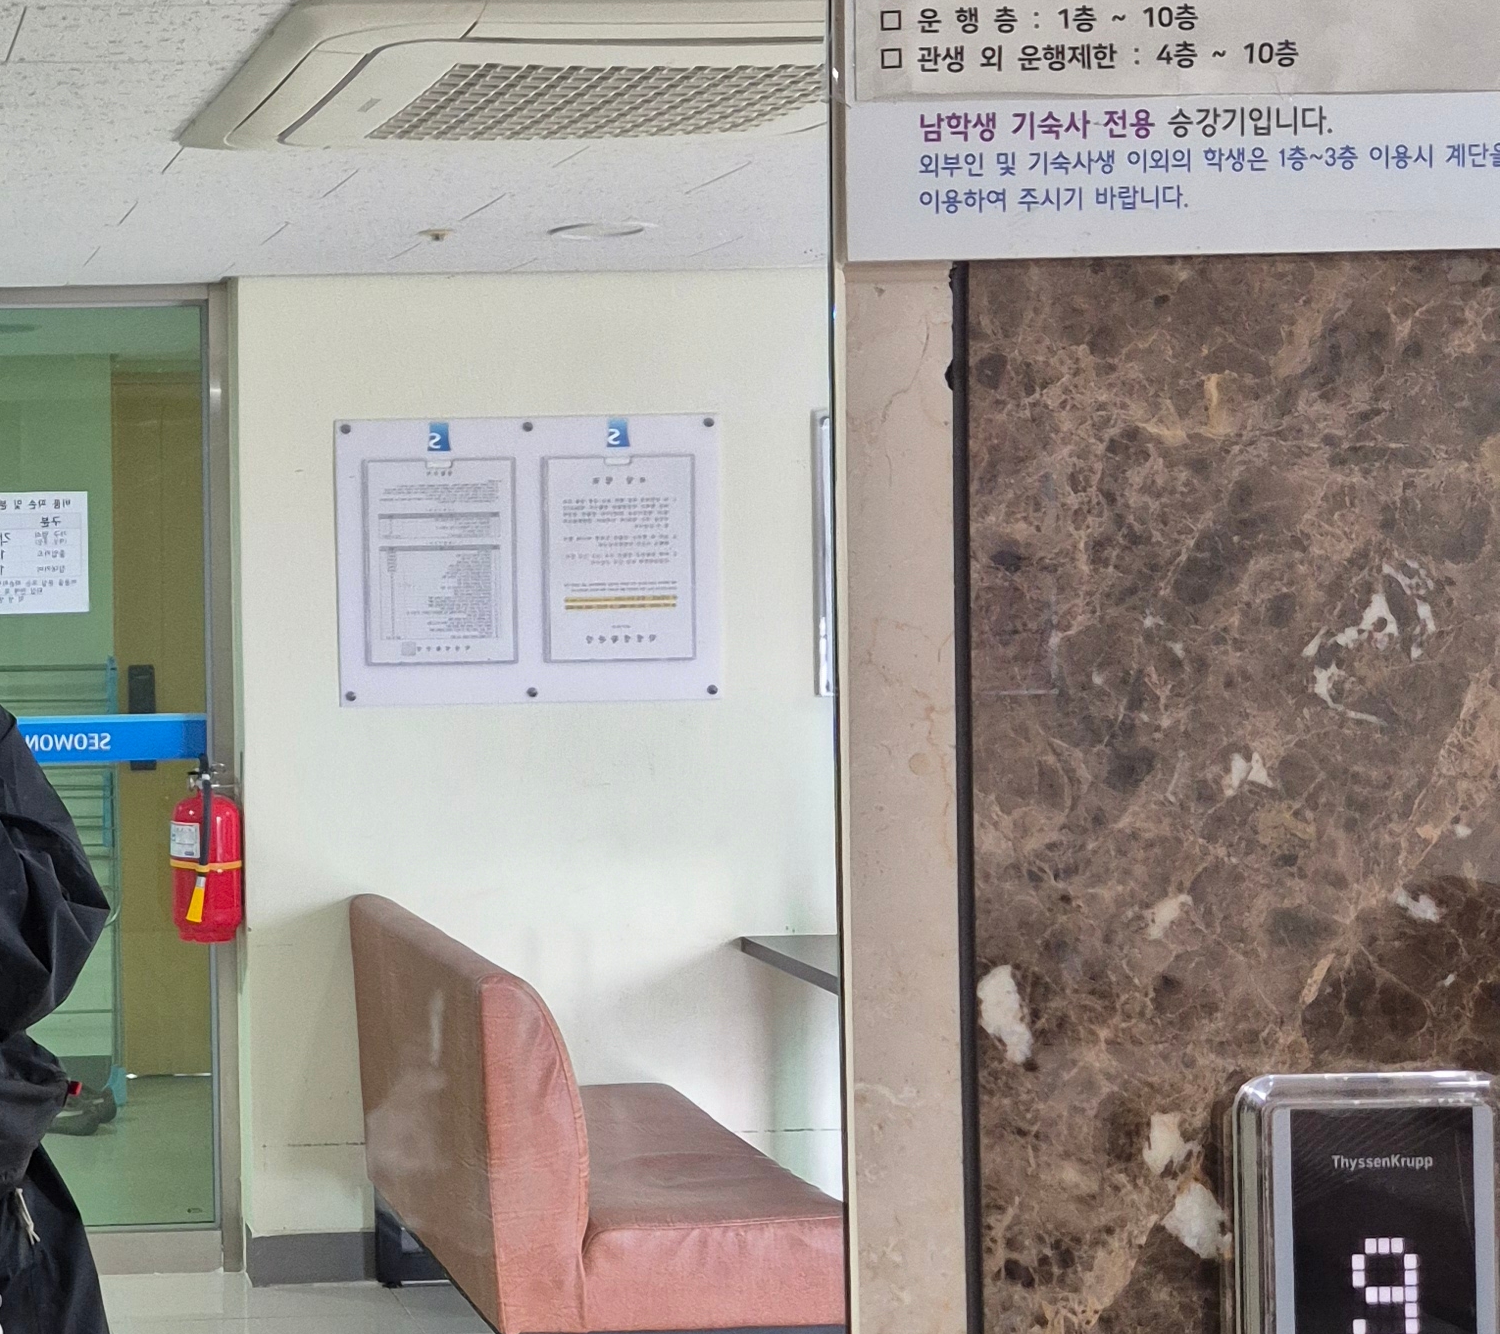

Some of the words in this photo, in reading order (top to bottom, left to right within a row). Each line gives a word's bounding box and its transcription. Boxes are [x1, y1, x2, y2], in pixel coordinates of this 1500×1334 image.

[1056, 4, 1098, 33] 1층
[1142, 3, 1200, 32] 10층
[915, 44, 966, 74] 관생
[979, 44, 1003, 73] 외
[1017, 42, 1119, 72] 운행제한
[1155, 40, 1199, 69] 4층
[1242, 39, 1300, 68] 10층
[918, 111, 998, 143] 남학생
[1010, 109, 1092, 141] 기숙사
[1101, 108, 1157, 140] 전용
[1166, 105, 1334, 140] 승강기입니다.
[917, 151, 984, 179] 외부인
[995, 151, 1017, 177] 및
[1027, 149, 1117, 176] 기숙사생
[1126, 147, 1193, 174] 이외의
[1202, 146, 1270, 173] 학생은
[1278, 144, 1359, 172] 1층~3층
[1368, 142, 1434, 170] 이용시
[919, 188, 1008, 214] 이용하여
[1017, 187, 1083, 213] 주시기
[1095, 185, 1189, 211] 바랍니다.
[1330, 1154, 1434, 1171] ThyssenKrupp
